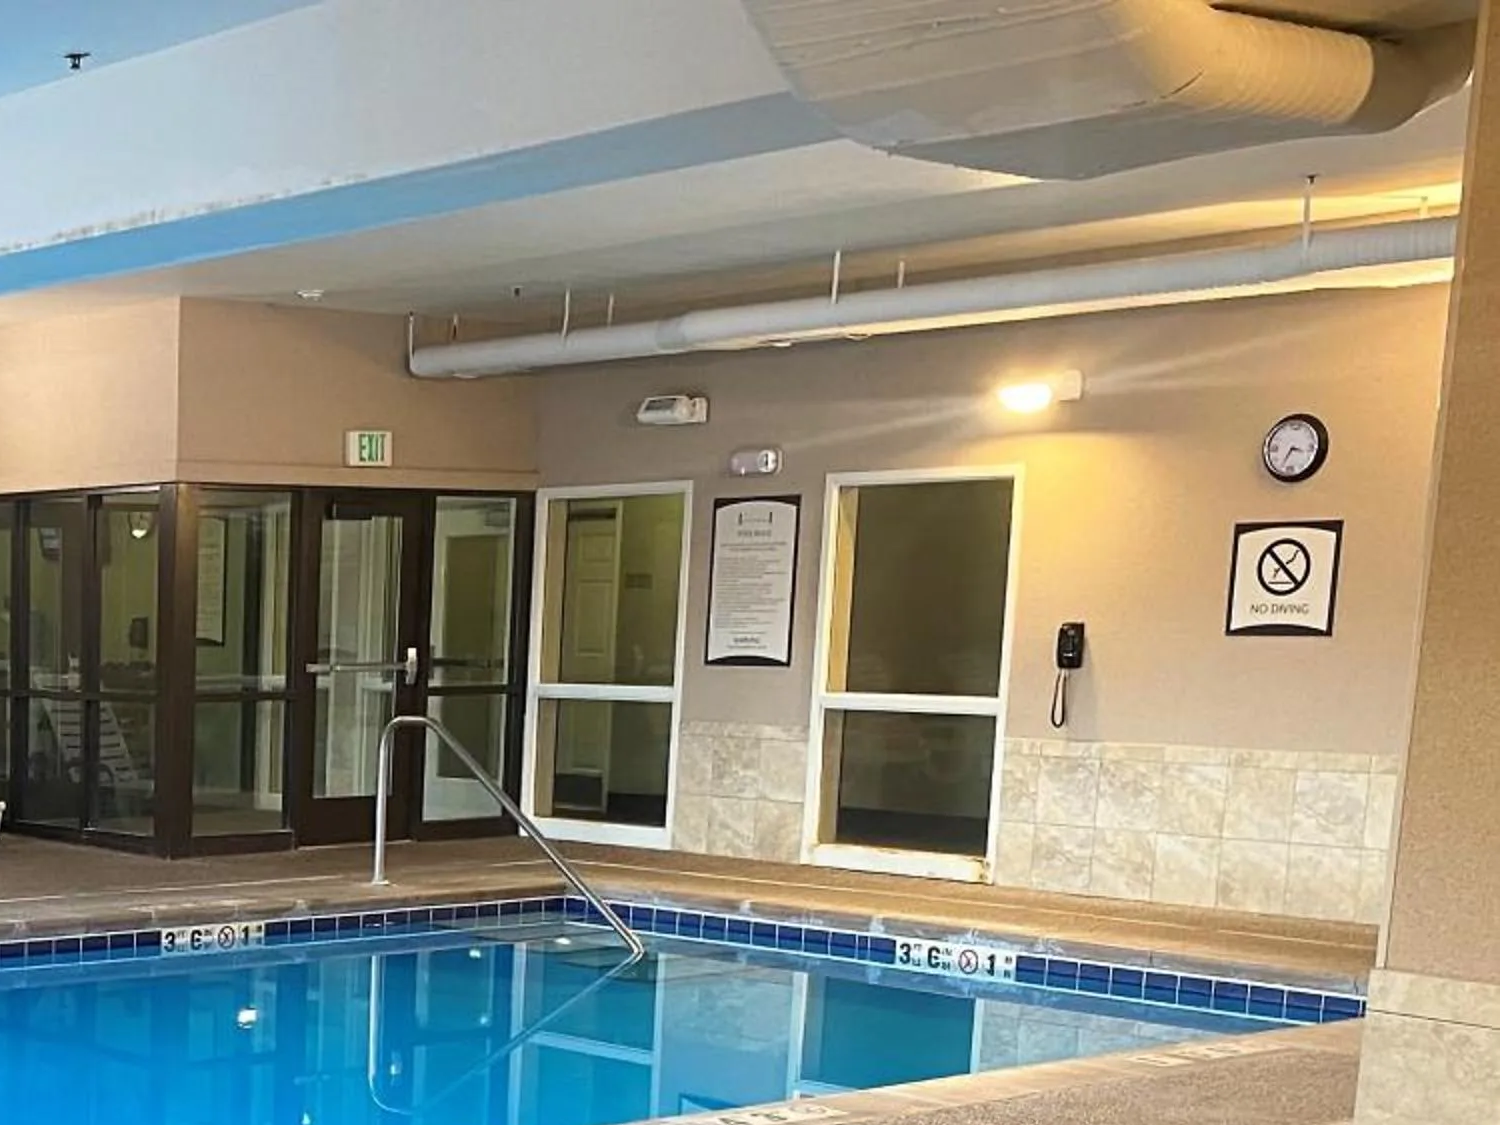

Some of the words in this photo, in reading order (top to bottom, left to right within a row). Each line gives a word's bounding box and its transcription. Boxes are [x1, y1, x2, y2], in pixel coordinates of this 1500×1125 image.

[358, 433, 386, 462] EXIT
[1250, 603, 1269, 614] NO
[1270, 602, 1310, 614] DIVING
